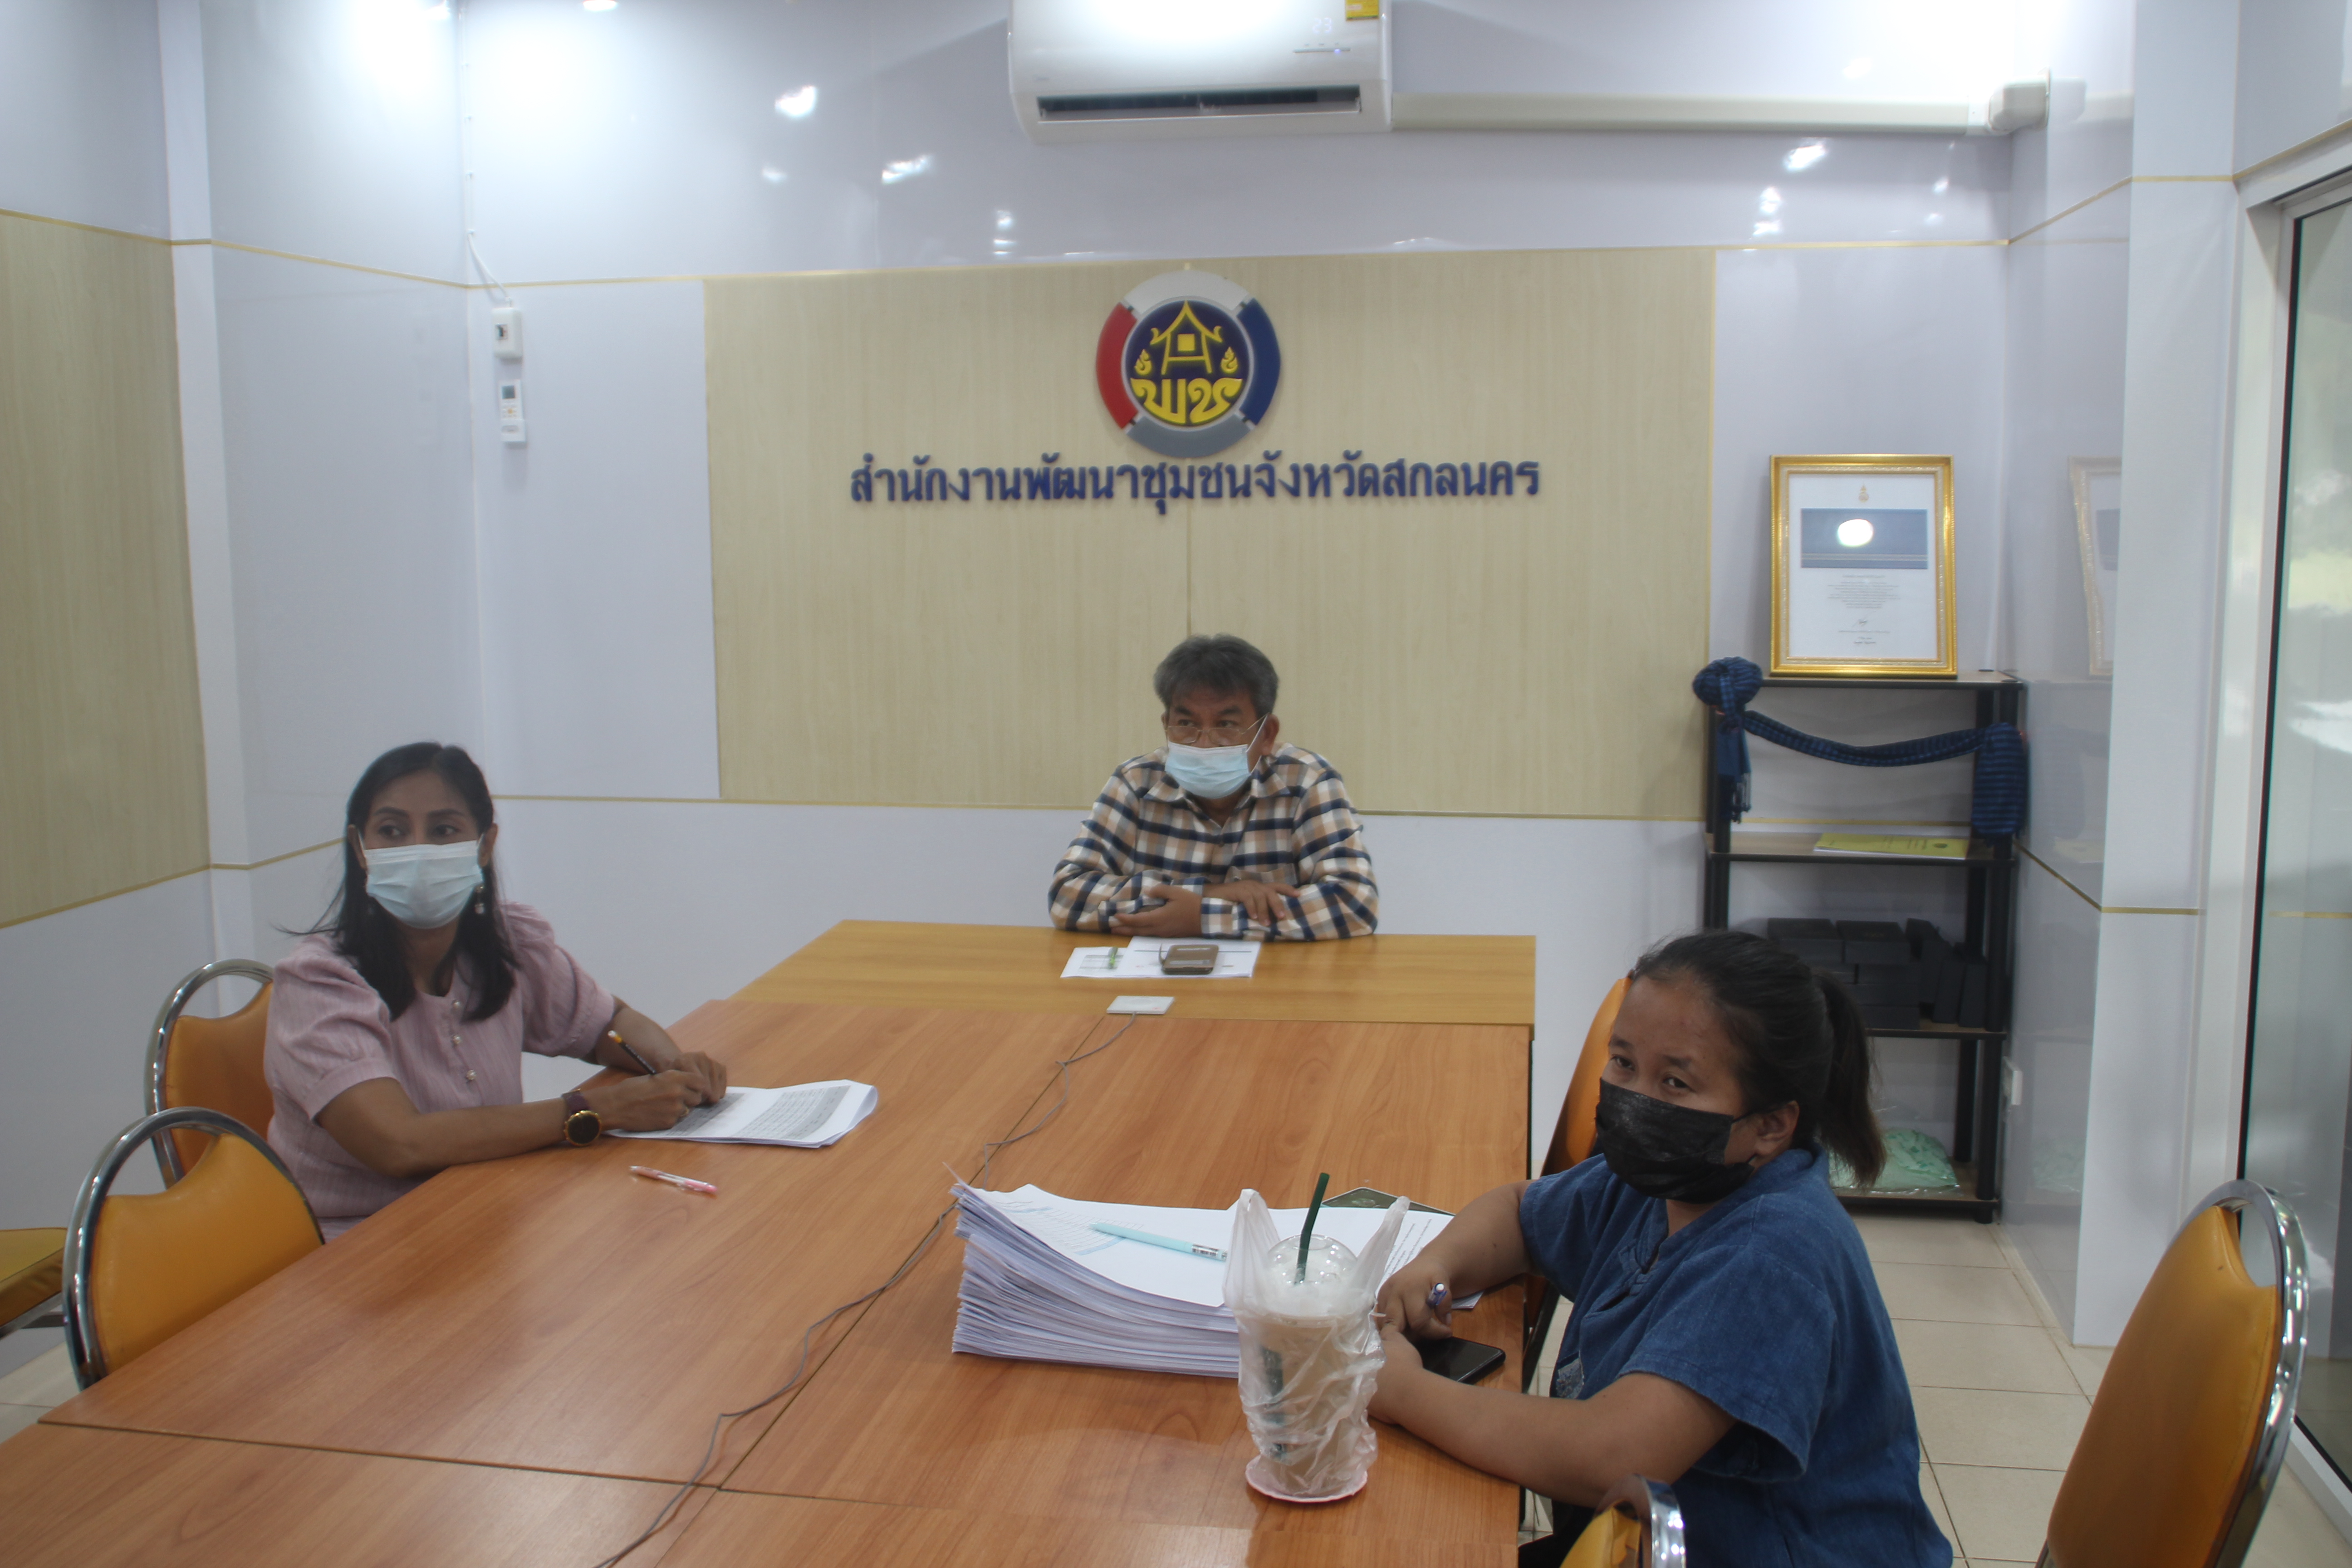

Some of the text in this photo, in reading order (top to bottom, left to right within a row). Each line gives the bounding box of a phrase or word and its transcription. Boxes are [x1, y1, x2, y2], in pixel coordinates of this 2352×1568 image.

[1313, 17, 1332, 34] 23
[851, 449, 1539, 514] สำนักงานพัฒนาชุมชนจังหวัดสกลนคร
